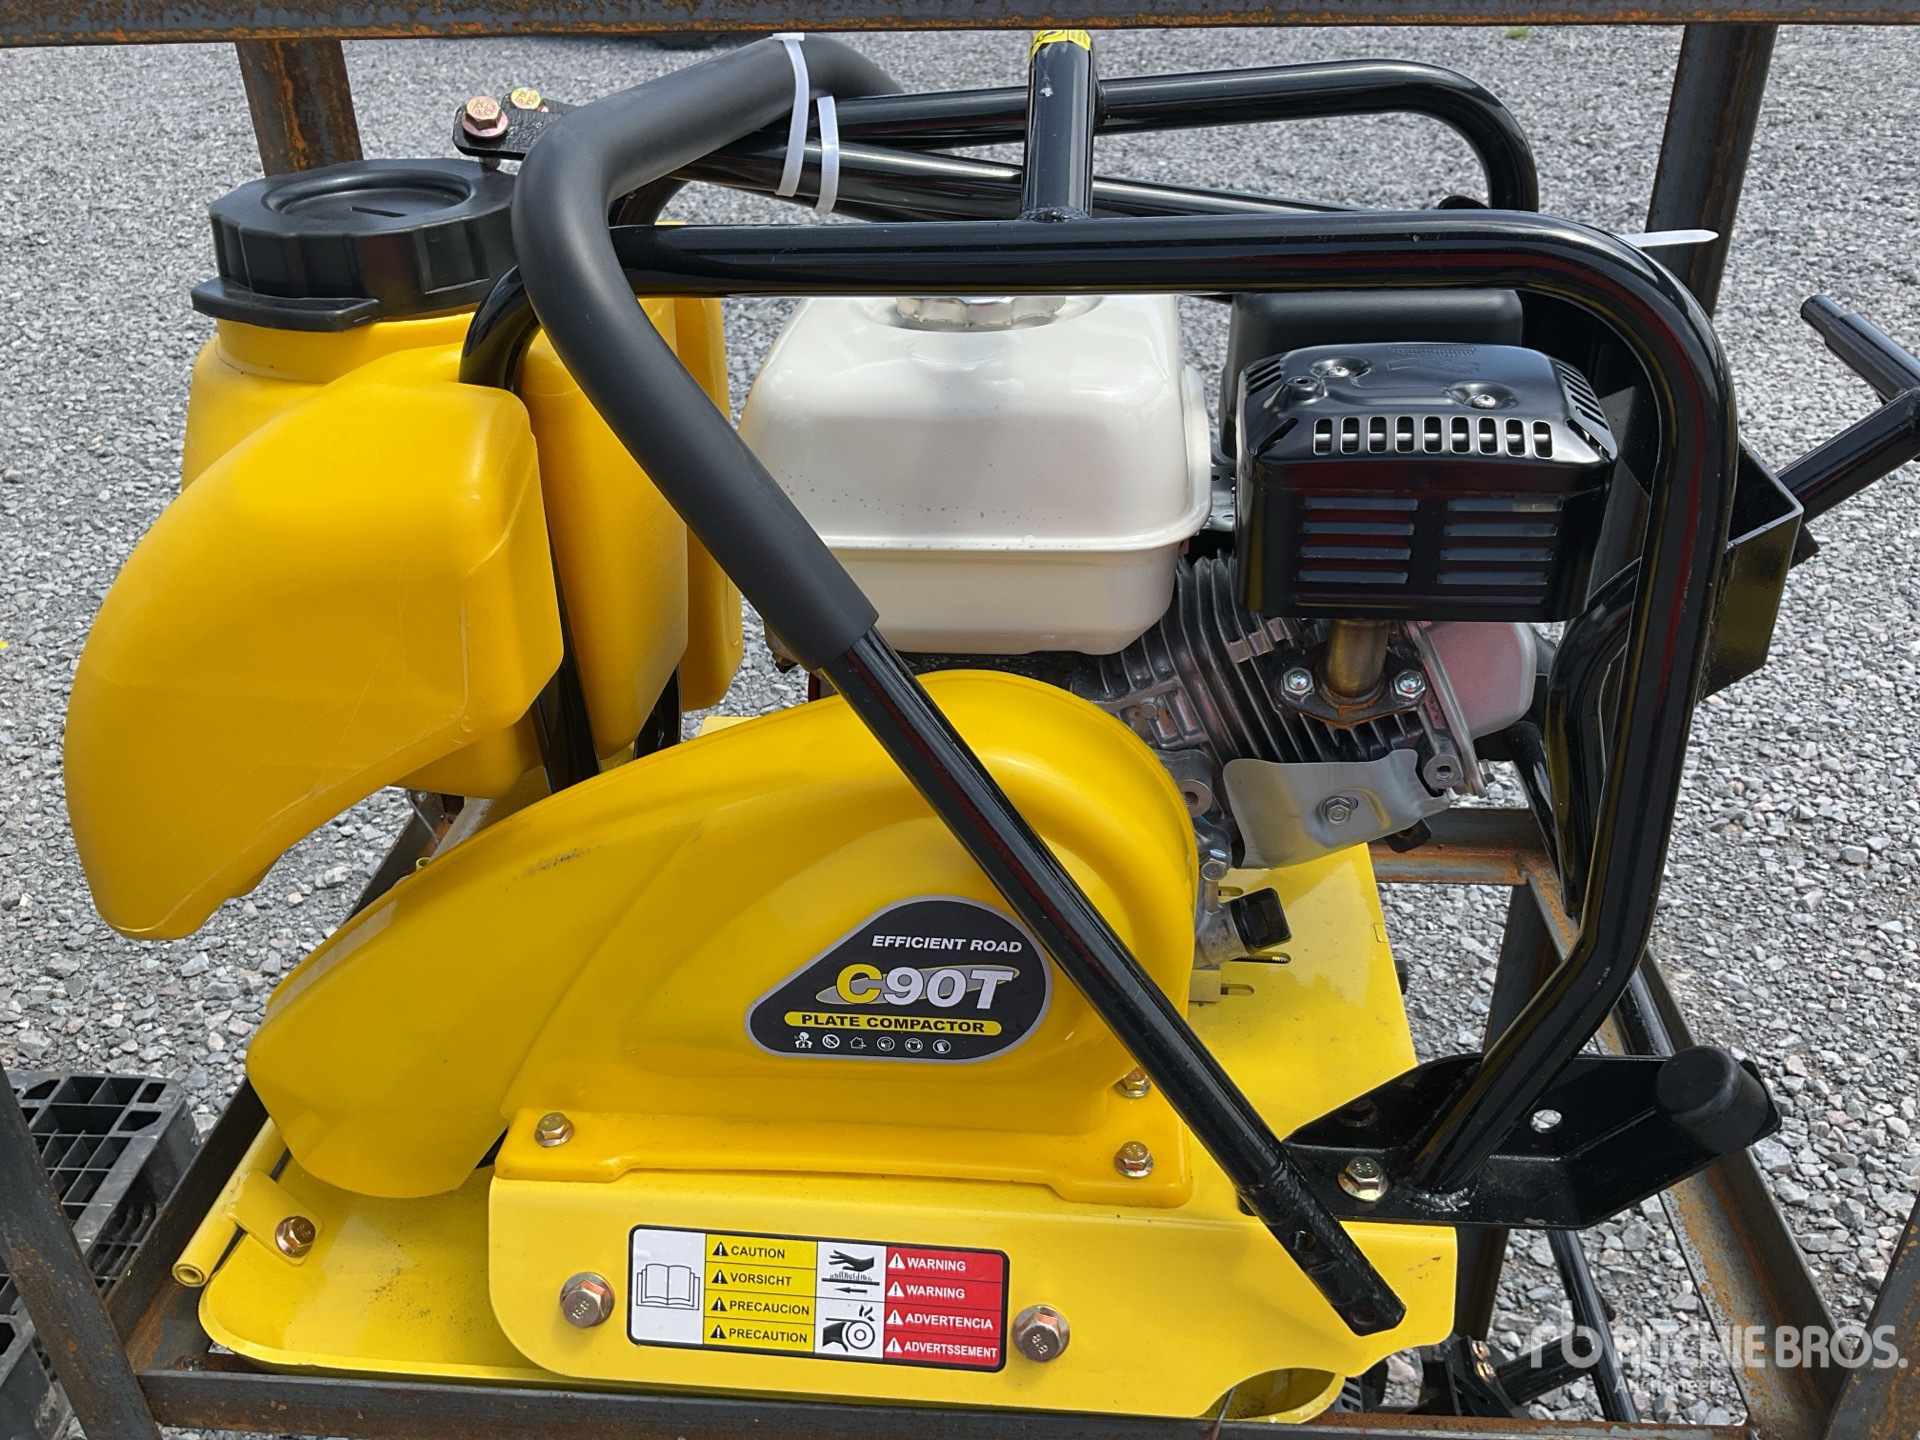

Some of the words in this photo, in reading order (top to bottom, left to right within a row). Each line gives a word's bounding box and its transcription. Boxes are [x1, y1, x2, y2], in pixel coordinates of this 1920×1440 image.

[871, 934, 966, 951] EFFICIENT
[969, 939, 1023, 954] ROAD
[836, 963, 1016, 1010] C90T
[801, 1014, 861, 1028] PLATE
[867, 1017, 984, 1033] COMPACTOR
[731, 1245, 785, 1259] CAUTION
[907, 1257, 966, 1272] WARNING
[729, 1272, 792, 1286] VORSICHT
[906, 1284, 965, 1299] WARNING
[729, 1300, 810, 1315] PRECAUCION
[905, 1312, 993, 1330] ADVERTENCIA
[729, 1328, 807, 1343] PRECAUTION
[904, 1340, 998, 1358] ADVERTSSEMENT
